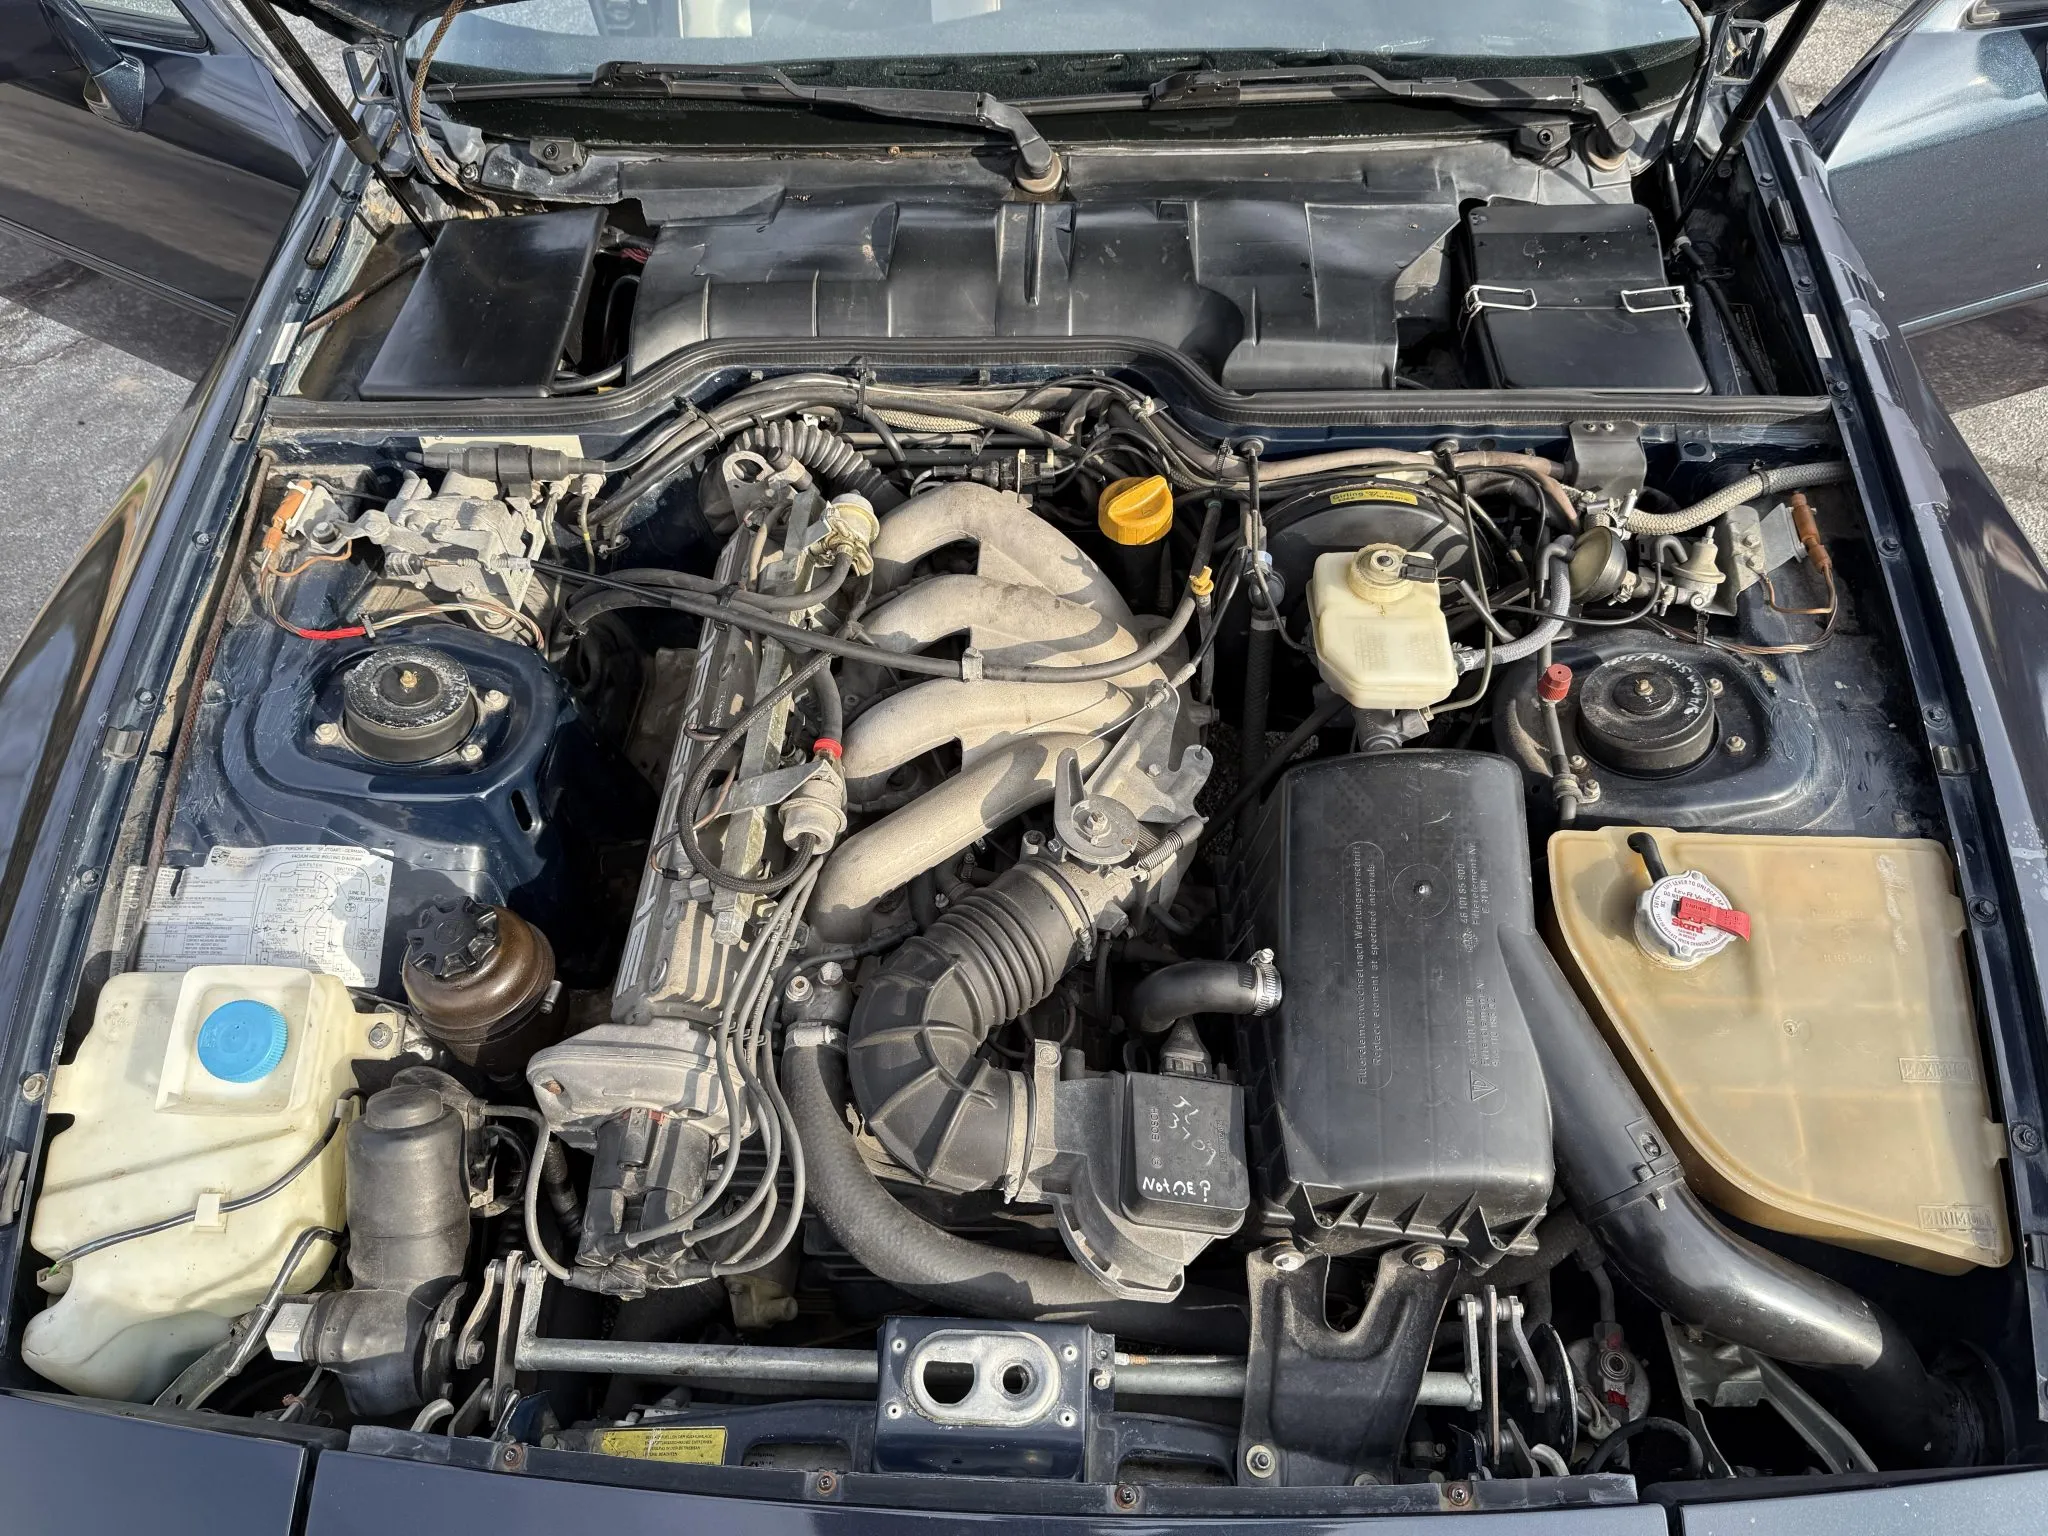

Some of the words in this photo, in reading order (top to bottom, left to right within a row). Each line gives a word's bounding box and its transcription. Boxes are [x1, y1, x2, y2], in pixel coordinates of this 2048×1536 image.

[1353, 846, 1364, 940] Wartungsvorschrift
[1367, 863, 1376, 907] intervals
[1368, 910, 1380, 957] specified
[1671, 917, 1704, 935] Stant
[1354, 943, 1365, 967] nach
[1371, 976, 1380, 1018] element
[1356, 968, 1368, 1085] Filterelementwechsel
[1372, 1022, 1384, 1066] Replace
[1904, 1061, 1969, 1078] MAXIMUM
[1150, 1106, 1160, 1142] BOSCH
[1142, 1176, 1171, 1195] Not
[1922, 1210, 1993, 1227] MINIMUM
